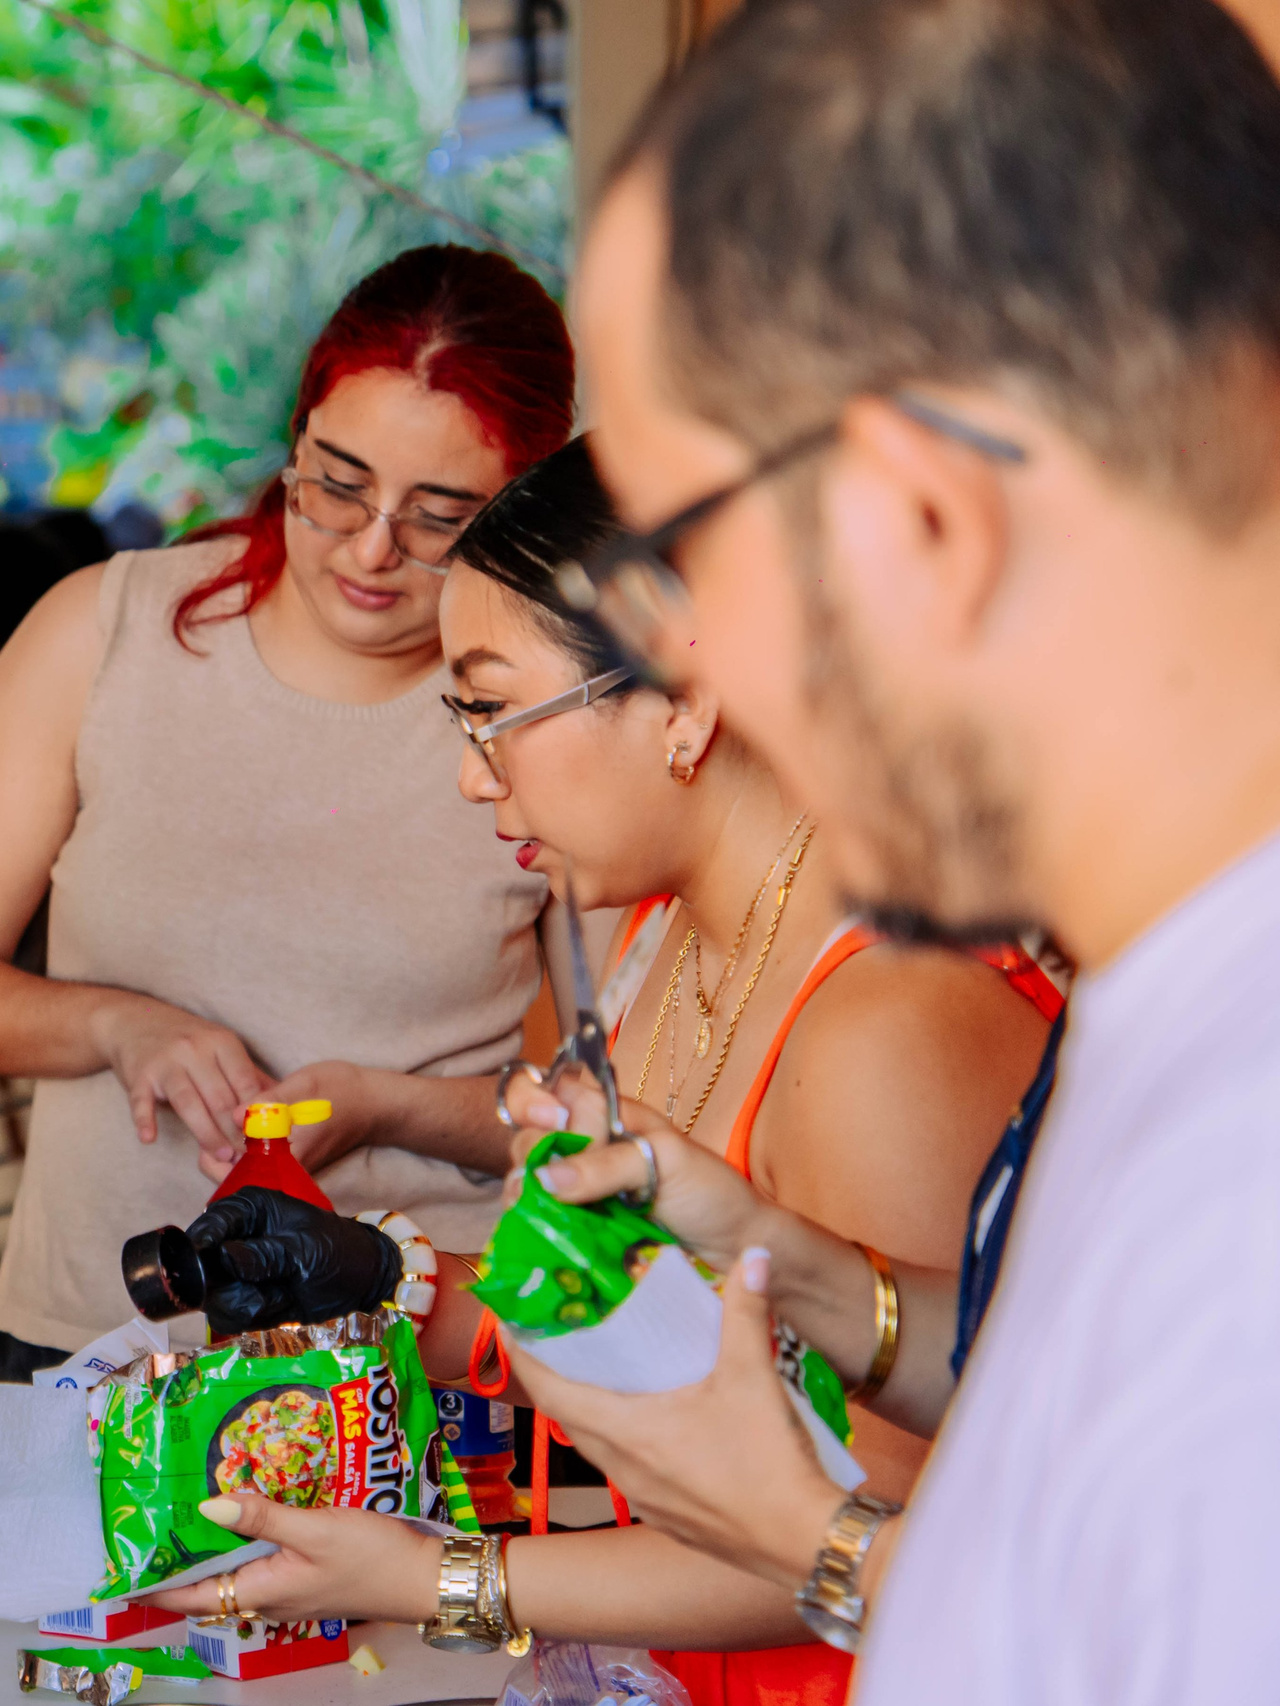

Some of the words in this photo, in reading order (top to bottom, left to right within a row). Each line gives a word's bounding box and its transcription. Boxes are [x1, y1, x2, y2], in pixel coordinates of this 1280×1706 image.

[338, 1388, 365, 1440] MÁS
[446, 1394, 456, 1409] 3
[344, 1442, 356, 1484] SALSA
